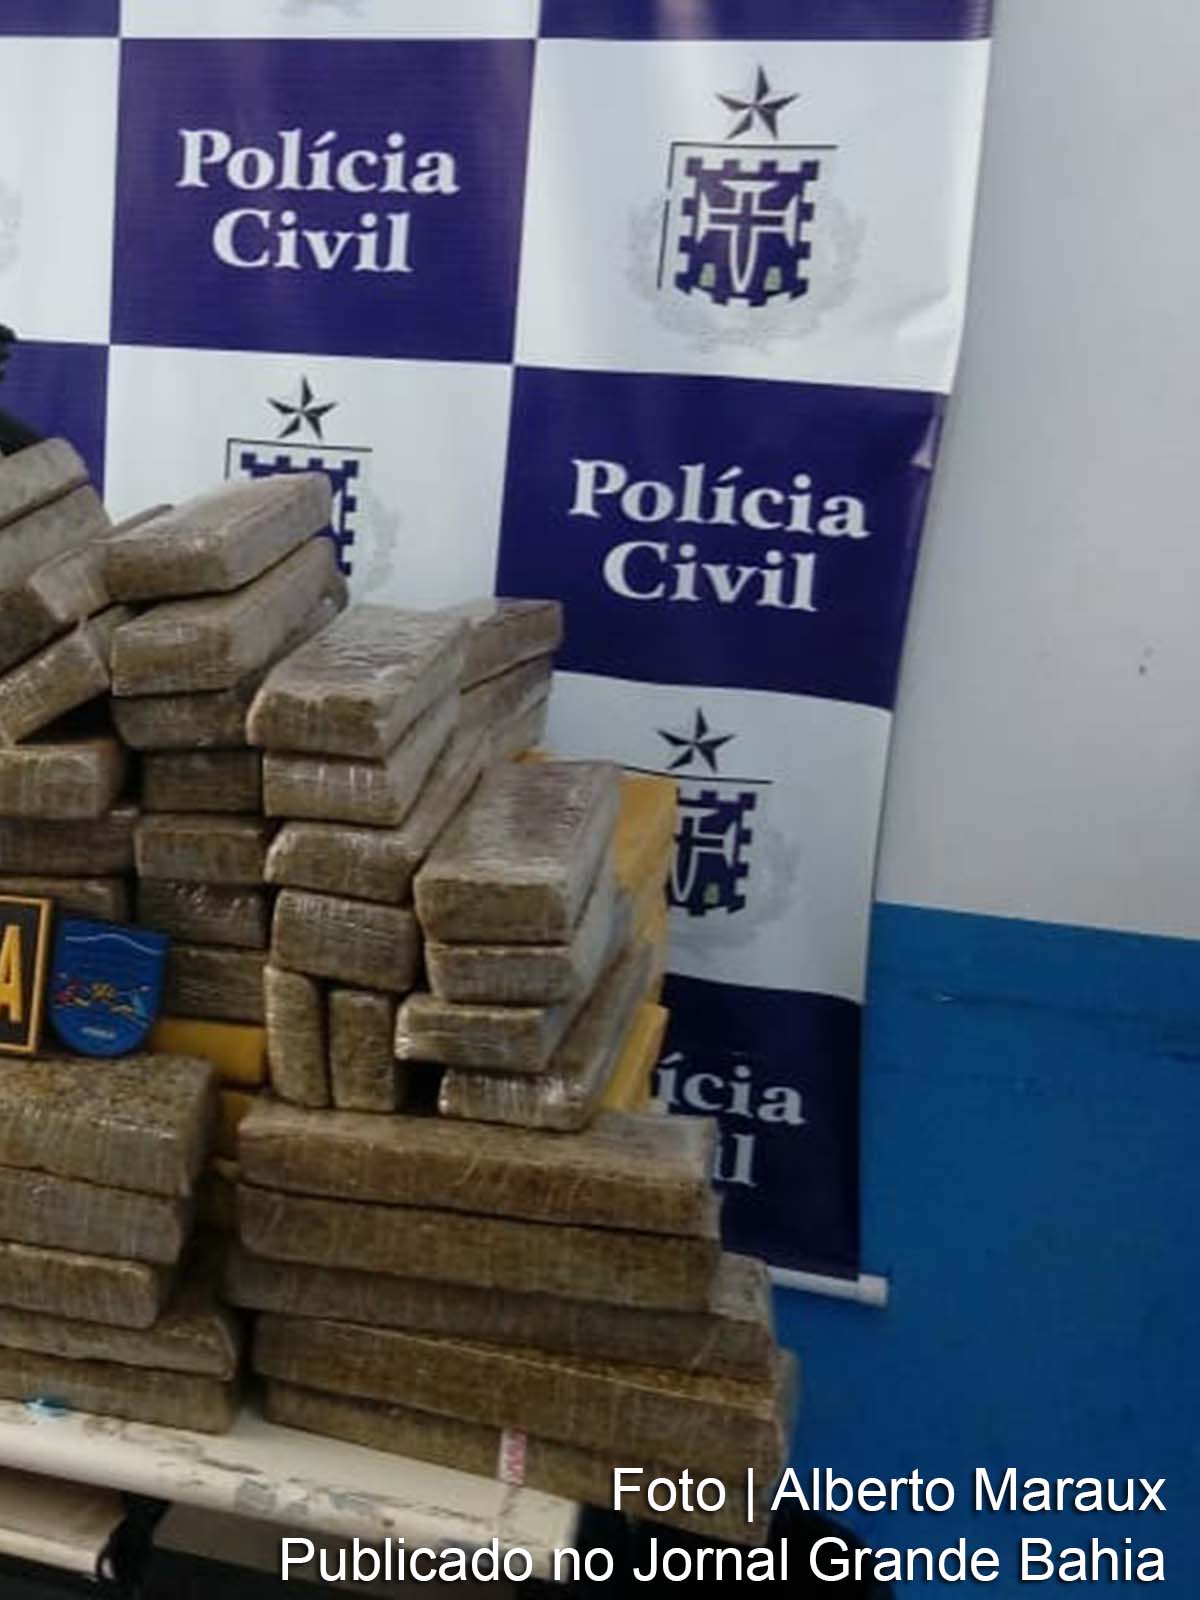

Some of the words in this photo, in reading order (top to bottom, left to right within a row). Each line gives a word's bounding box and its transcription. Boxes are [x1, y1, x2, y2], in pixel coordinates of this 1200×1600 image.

[175, 127, 461, 196] Polícia
[211, 207, 413, 275] Civil
[568, 457, 870, 540] Polícia
[601, 539, 818, 613] Civil
[655, 1051, 807, 1126] ícia
